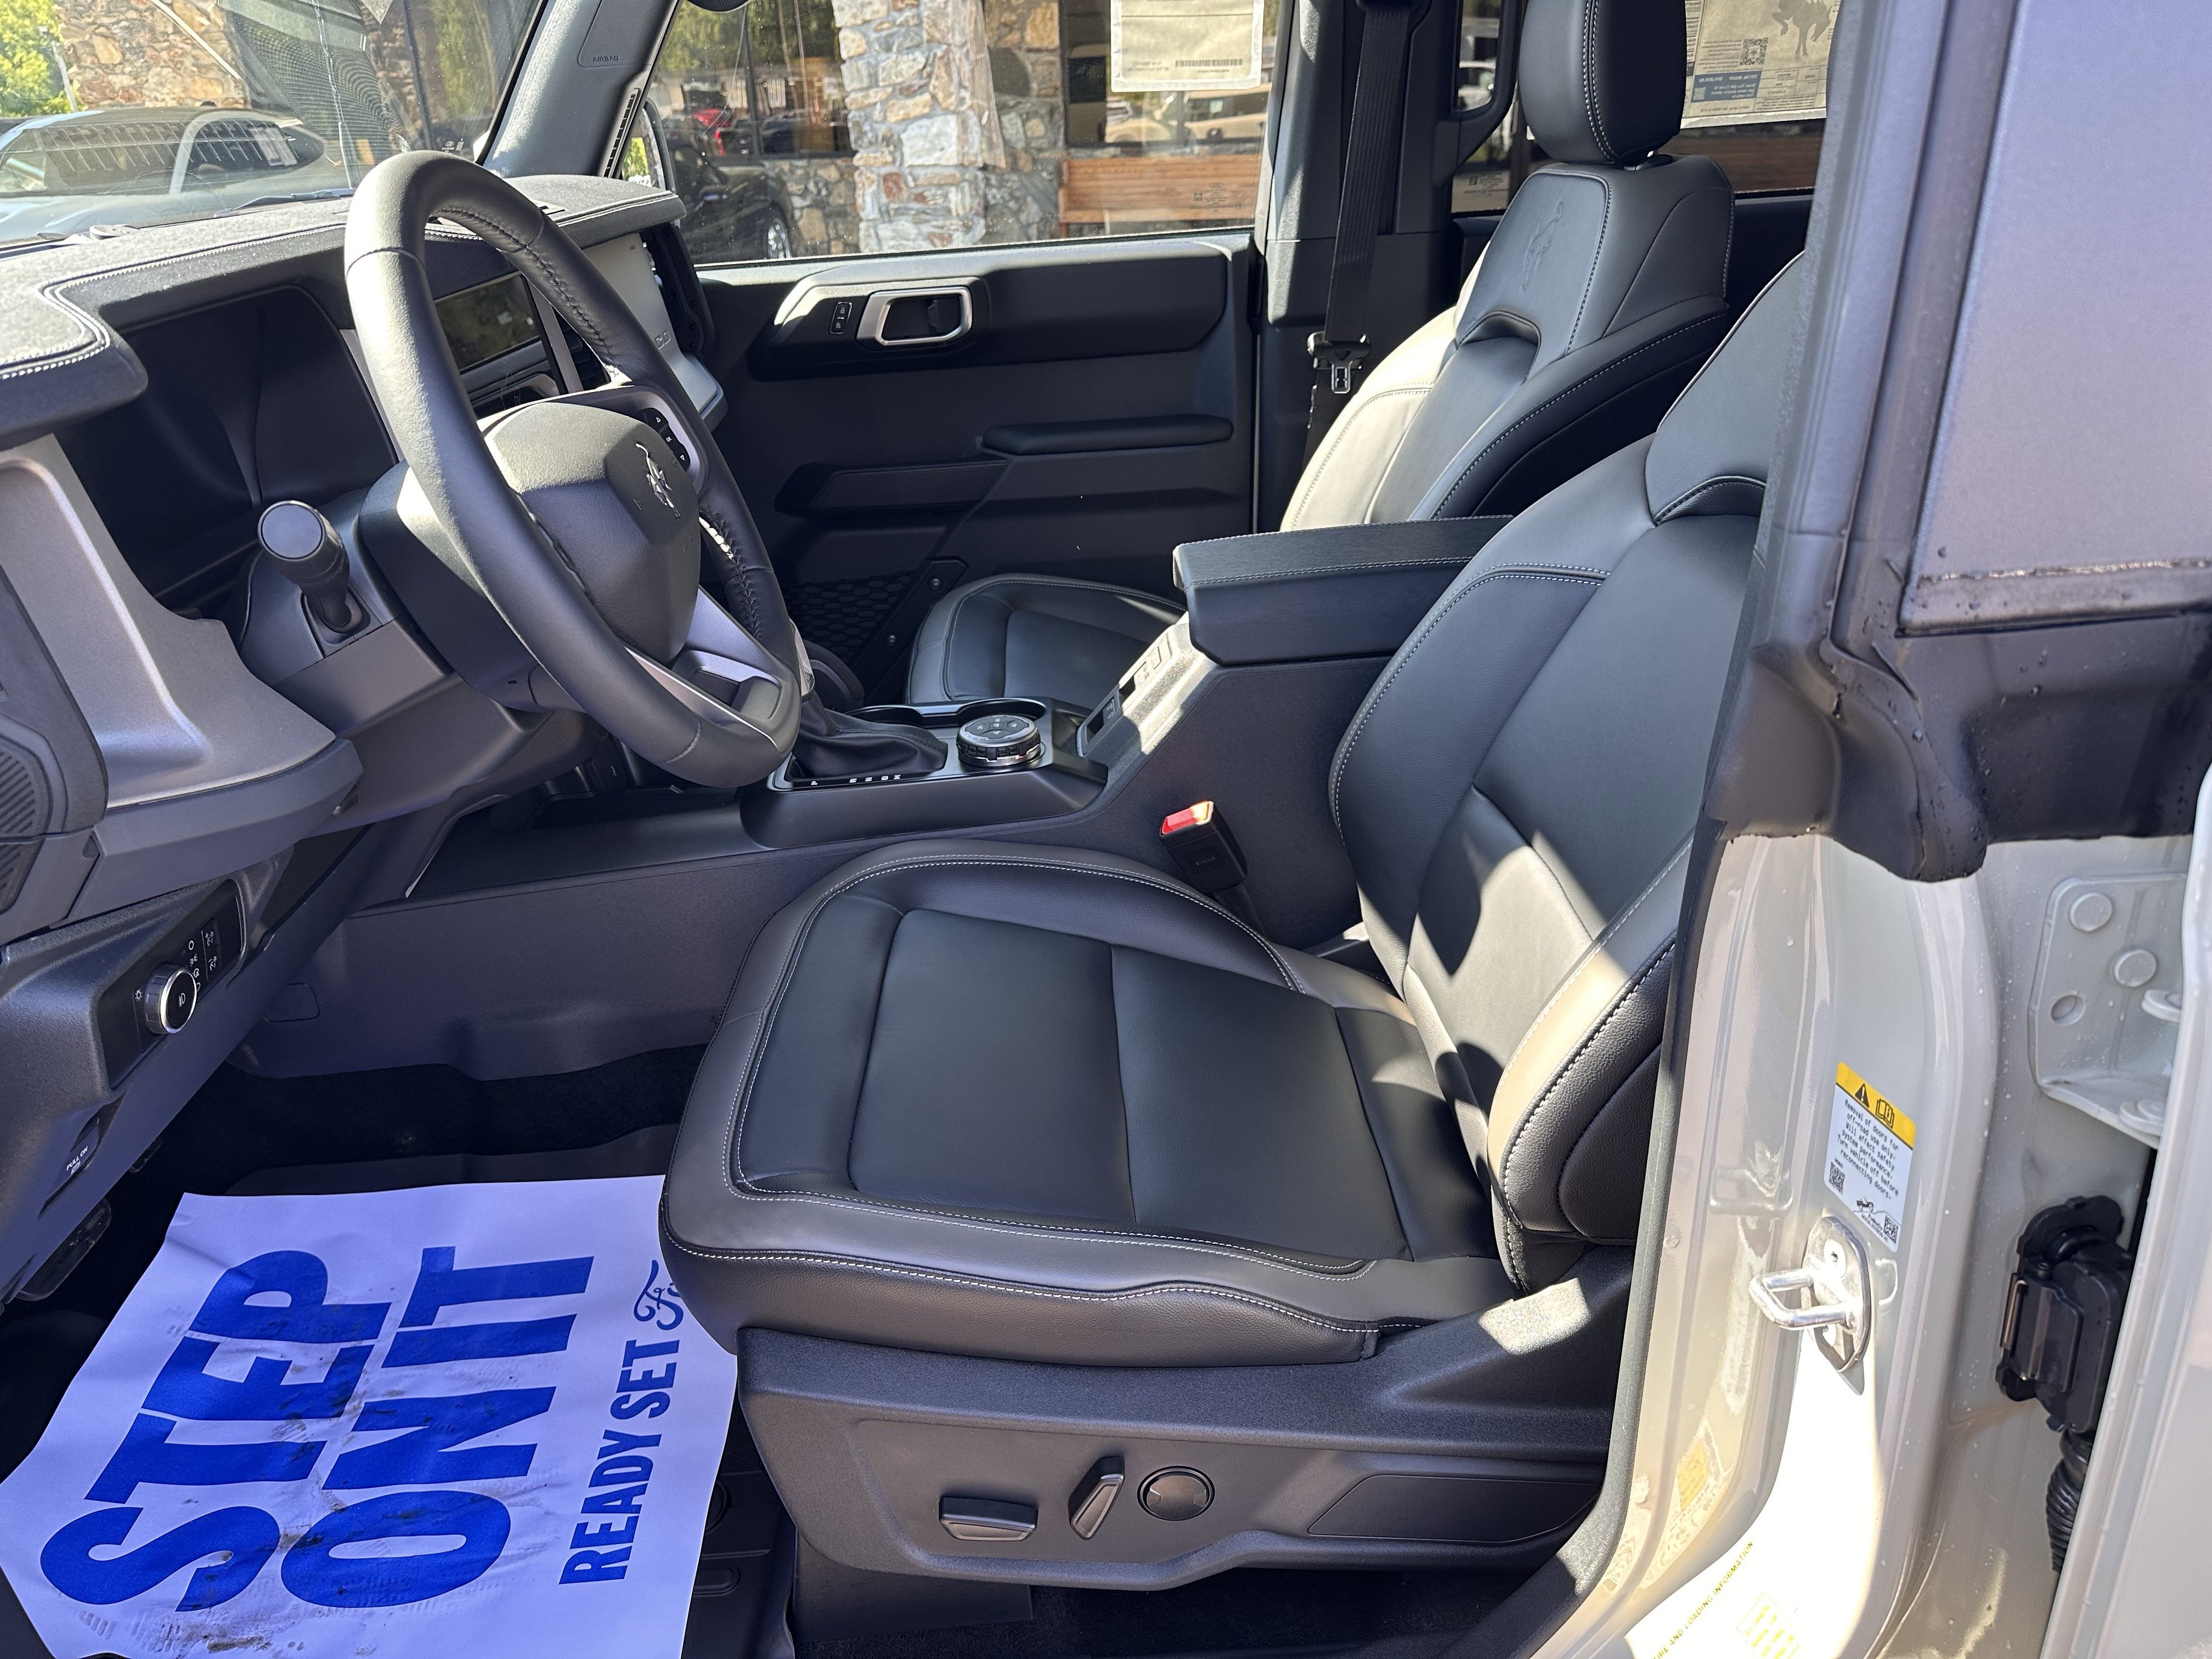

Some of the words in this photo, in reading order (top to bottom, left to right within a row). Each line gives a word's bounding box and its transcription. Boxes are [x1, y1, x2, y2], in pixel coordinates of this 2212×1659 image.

[1842, 1130, 1858, 1147] system
[1844, 1099, 1863, 1120] Removal
[1872, 1125, 1887, 1142] doors
[1847, 1113, 1869, 1136] off-road
[1870, 1134, 1878, 1146] use
[66, 1156, 80, 1171] PULL
[80, 1146, 88, 1157] ON
[1837, 1133, 1848, 1149] Turn
[1850, 1148, 1868, 1168] vehicle
[1870, 1166, 1878, 1176] off
[1881, 1175, 1898, 1195] before
[1841, 1149, 1872, 1184] reconnecting
[1846, 1121, 1856, 1136] Will
[1858, 1135, 1875, 1153] affect
[1877, 1151, 1894, 1171] safety
[40, 1250, 392, 1612] STEP
[558, 1429, 662, 1585] READY
[610, 1339, 680, 1420] SET
[1669, 1629, 1683, 1645] AND
[1713, 1541, 1753, 1595] INFORMATION
